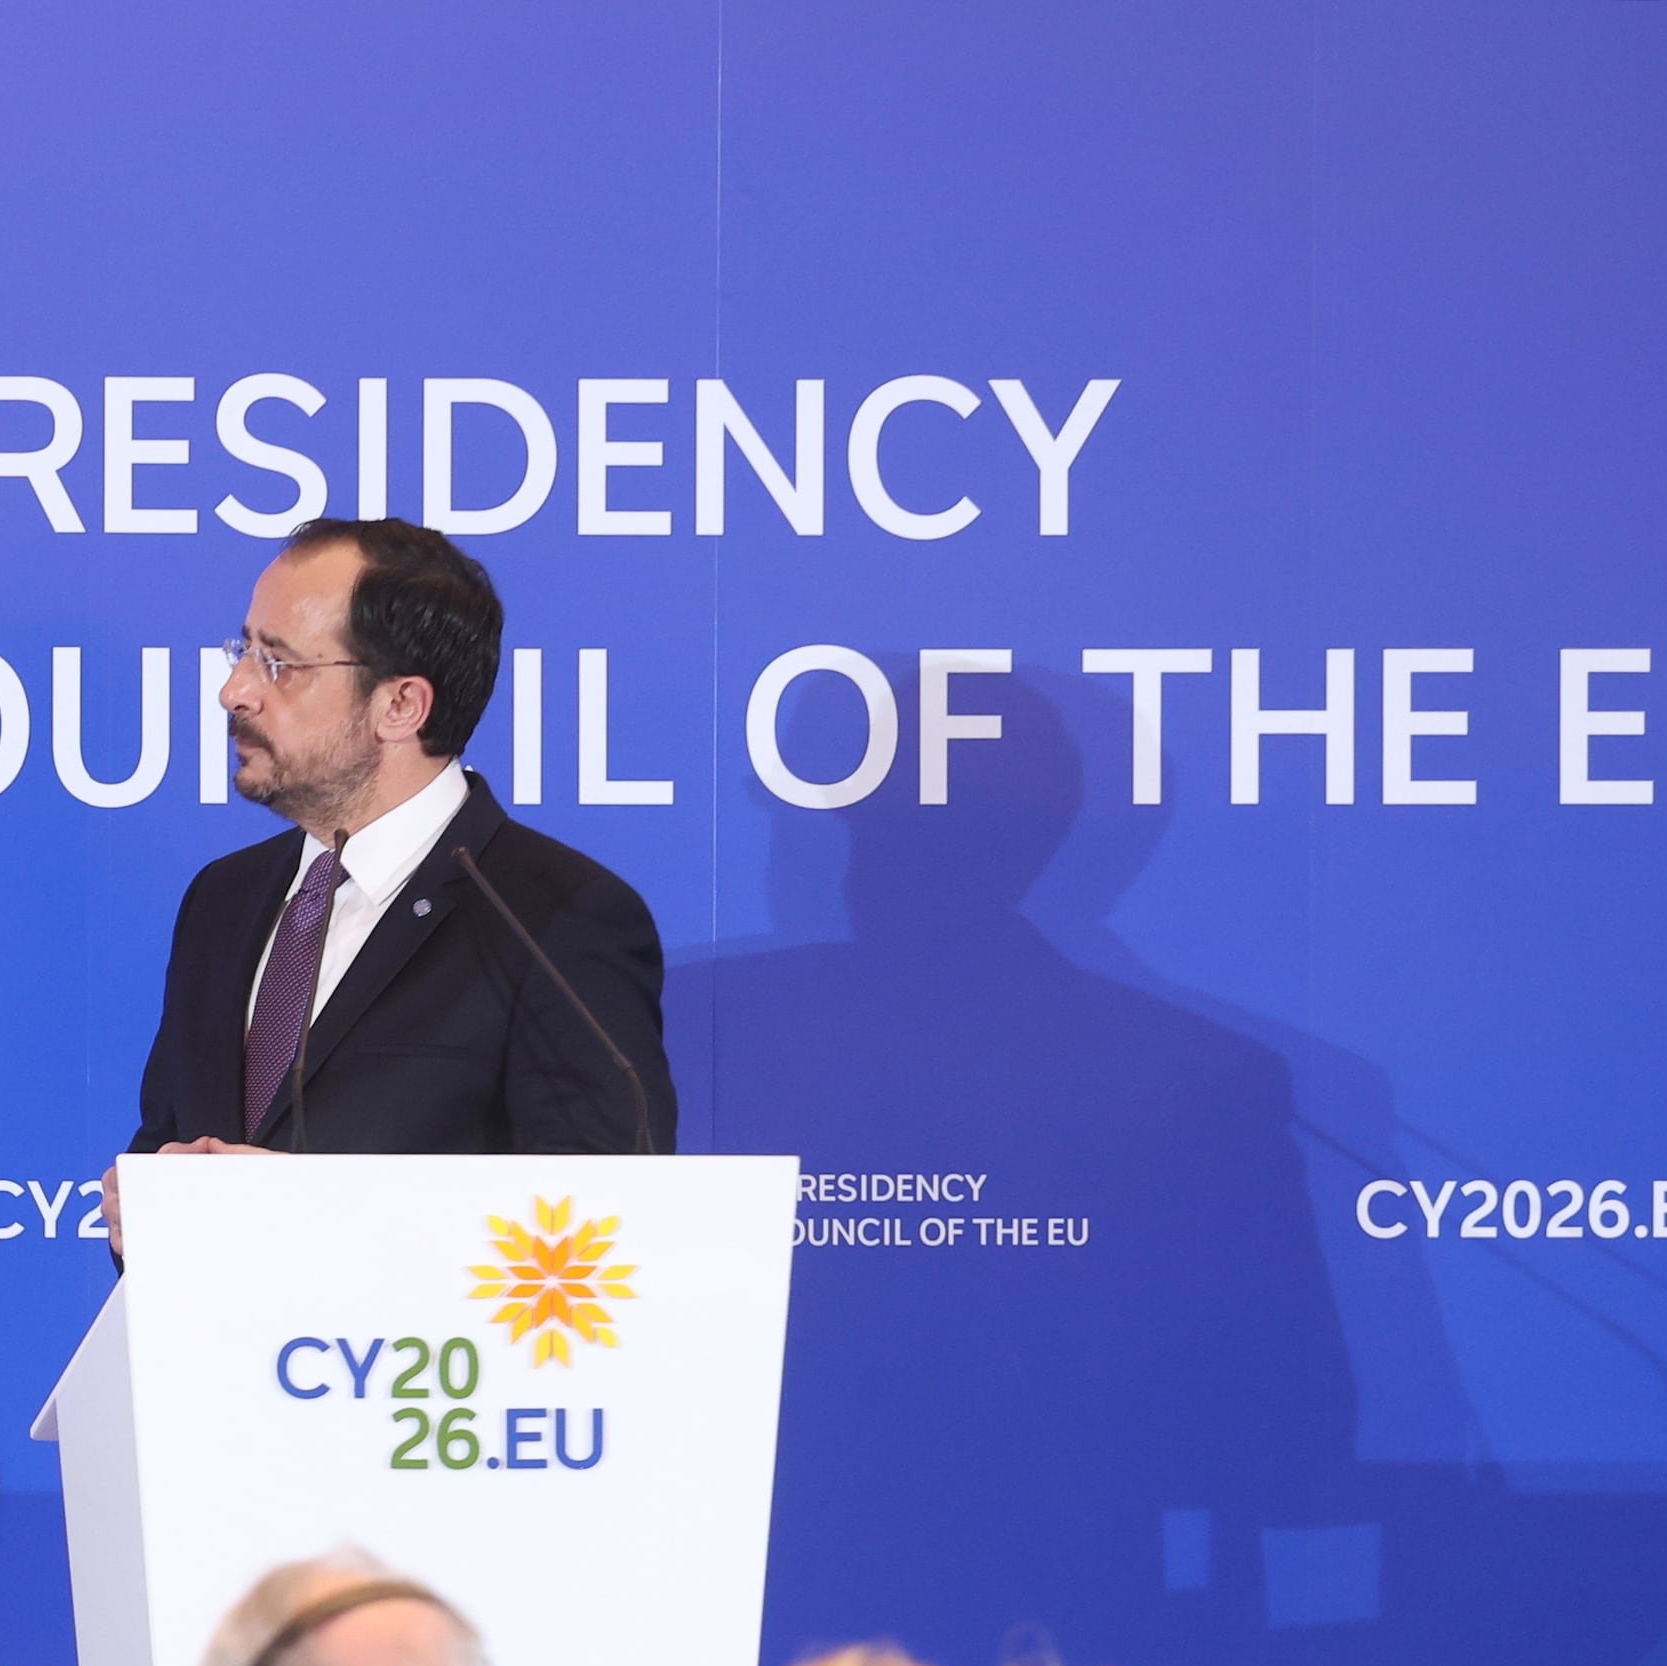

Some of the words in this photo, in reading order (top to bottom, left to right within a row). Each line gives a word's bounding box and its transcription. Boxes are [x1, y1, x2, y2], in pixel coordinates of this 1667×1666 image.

[745, 644, 1014, 809] OF
[1081, 647, 1478, 805] THE
[918, 1217, 966, 1247] OF
[971, 1217, 1040, 1247] THE
[1047, 1217, 1090, 1247] EU
[276, 1336, 480, 1400] CY20
[390, 1407, 604, 1471] 26.EU
